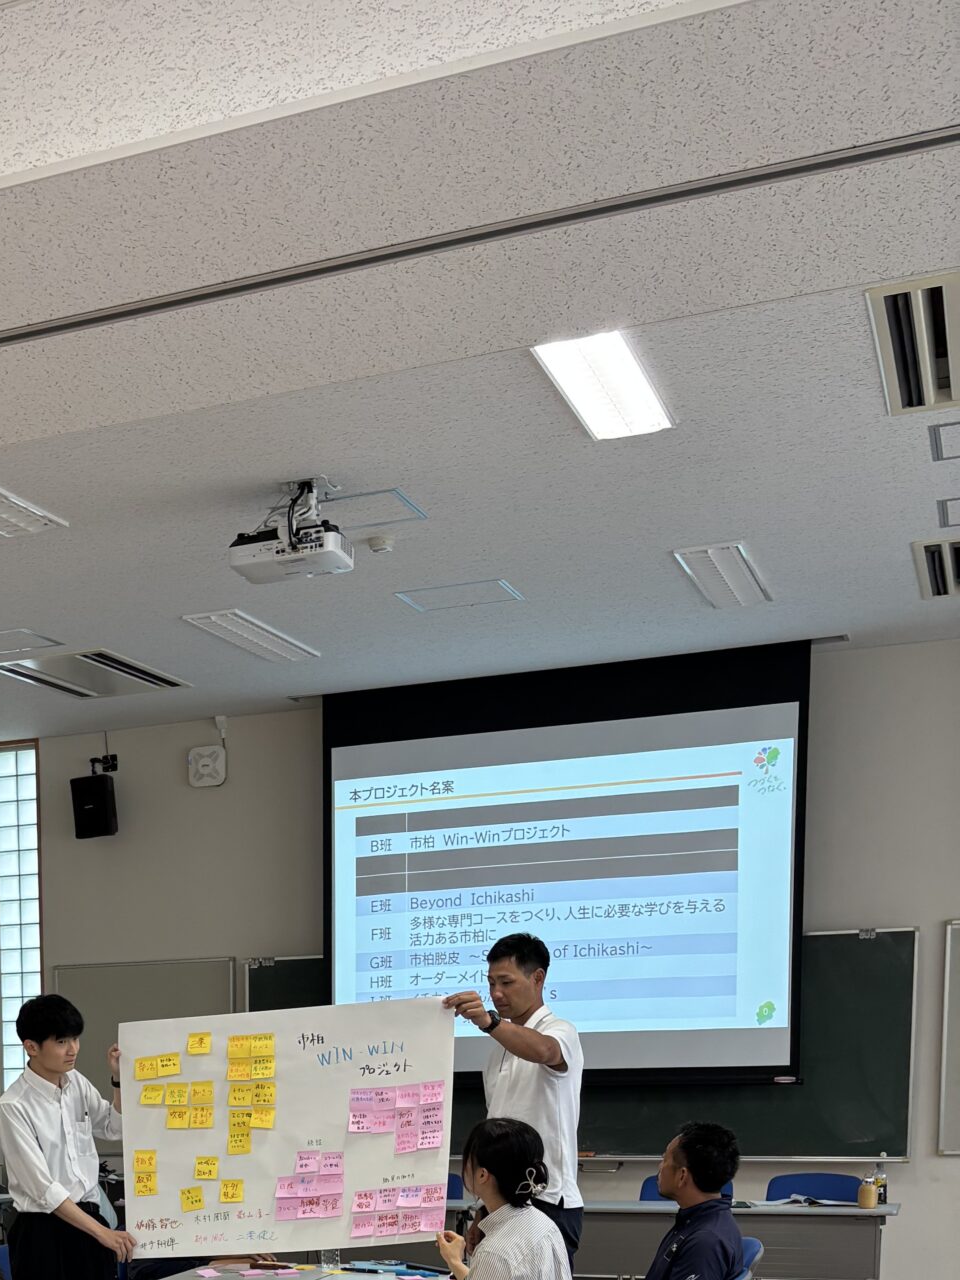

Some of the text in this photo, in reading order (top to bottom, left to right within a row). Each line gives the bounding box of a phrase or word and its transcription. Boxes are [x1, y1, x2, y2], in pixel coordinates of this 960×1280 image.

[349, 779, 455, 803] 本プロジェクト名案
[370, 823, 571, 853] B班 市柏 Win-Winプロジェクト
[371, 898, 392, 913] E班
[410, 888, 535, 911] Beyond Ichikashi
[410, 898, 726, 932] 多様な専門コースをつくり、人生に必要な学びを与える
[371, 927, 392, 941] F班
[409, 929, 497, 947] 活力ある市柏に
[370, 955, 393, 969] G班
[409, 952, 460, 968] 市柏脱皮
[370, 975, 393, 989] H班
[358, 1057, 414, 1077] プロジェクト
